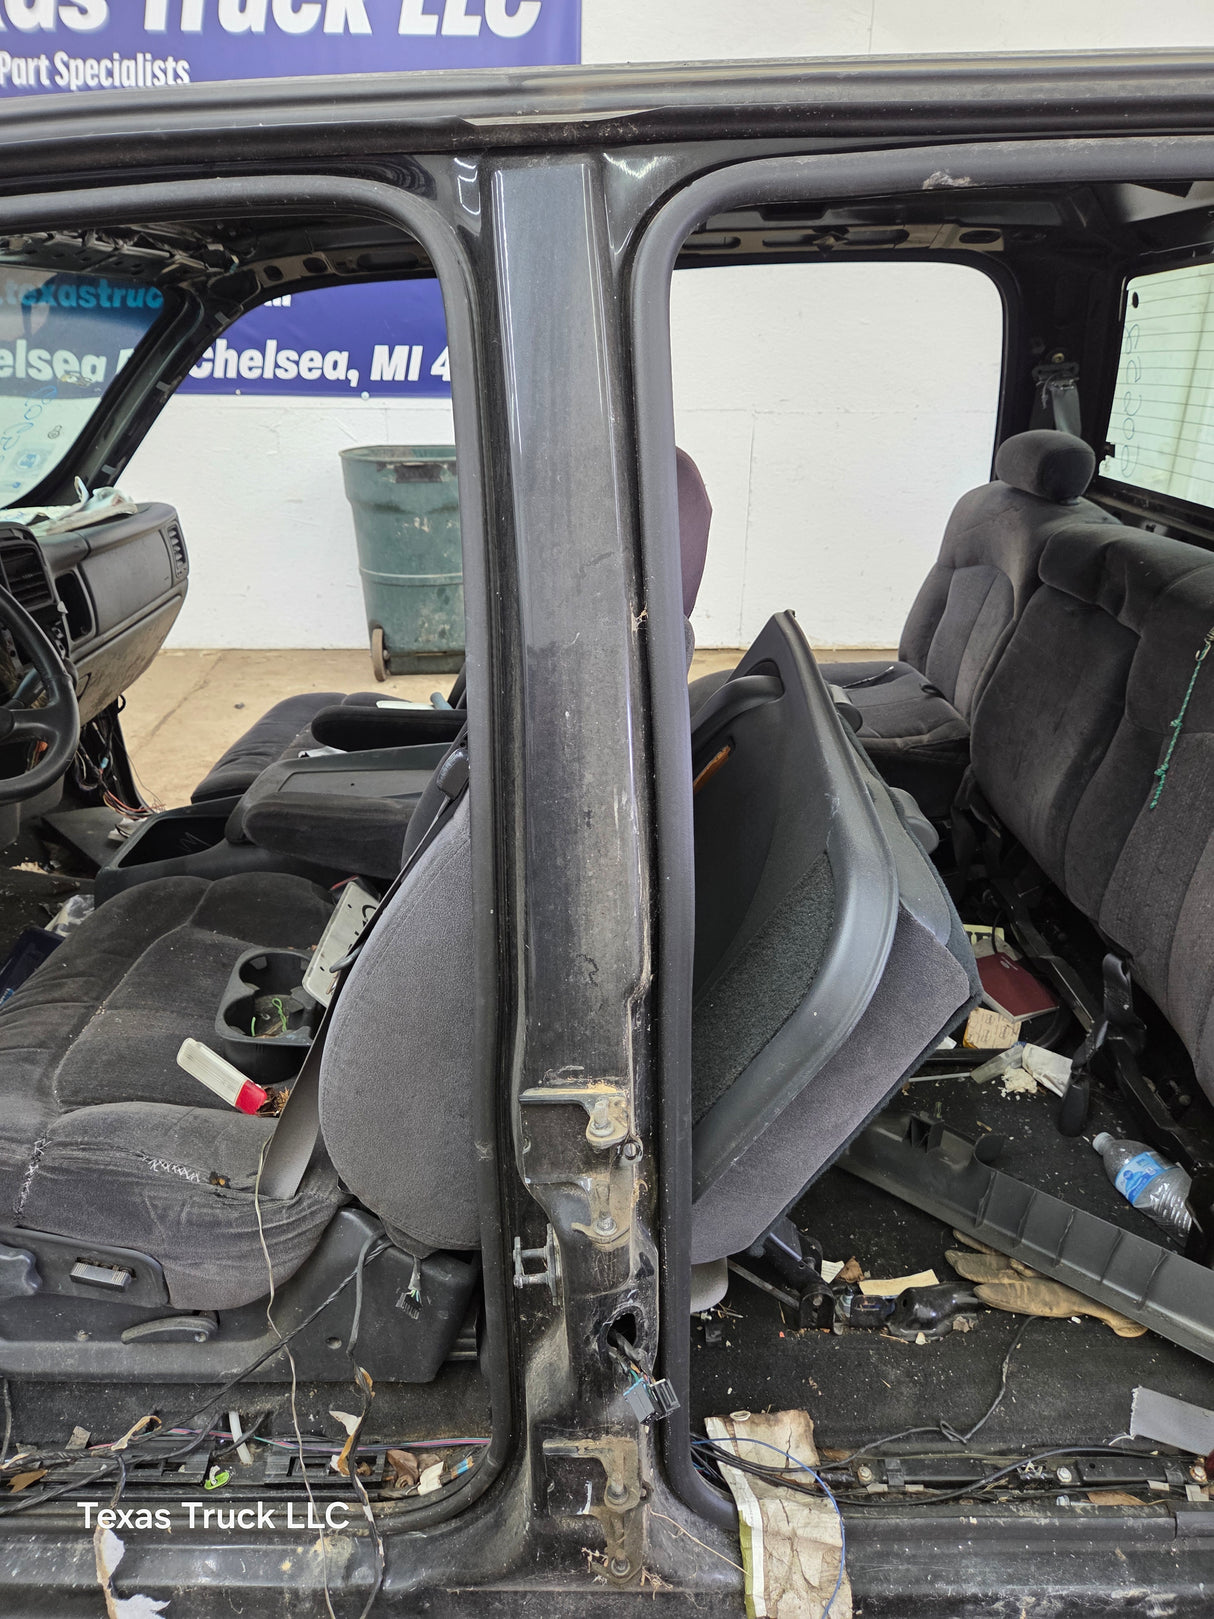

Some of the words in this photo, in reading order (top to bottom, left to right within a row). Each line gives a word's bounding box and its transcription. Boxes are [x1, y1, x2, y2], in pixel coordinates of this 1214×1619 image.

[0, 0, 108, 32] as
[398, 0, 542, 38] LLC
[0, 51, 50, 88] Part
[53, 50, 191, 92] Specialists
[188, 338, 360, 388] Chelsea,
[370, 344, 424, 381] MI
